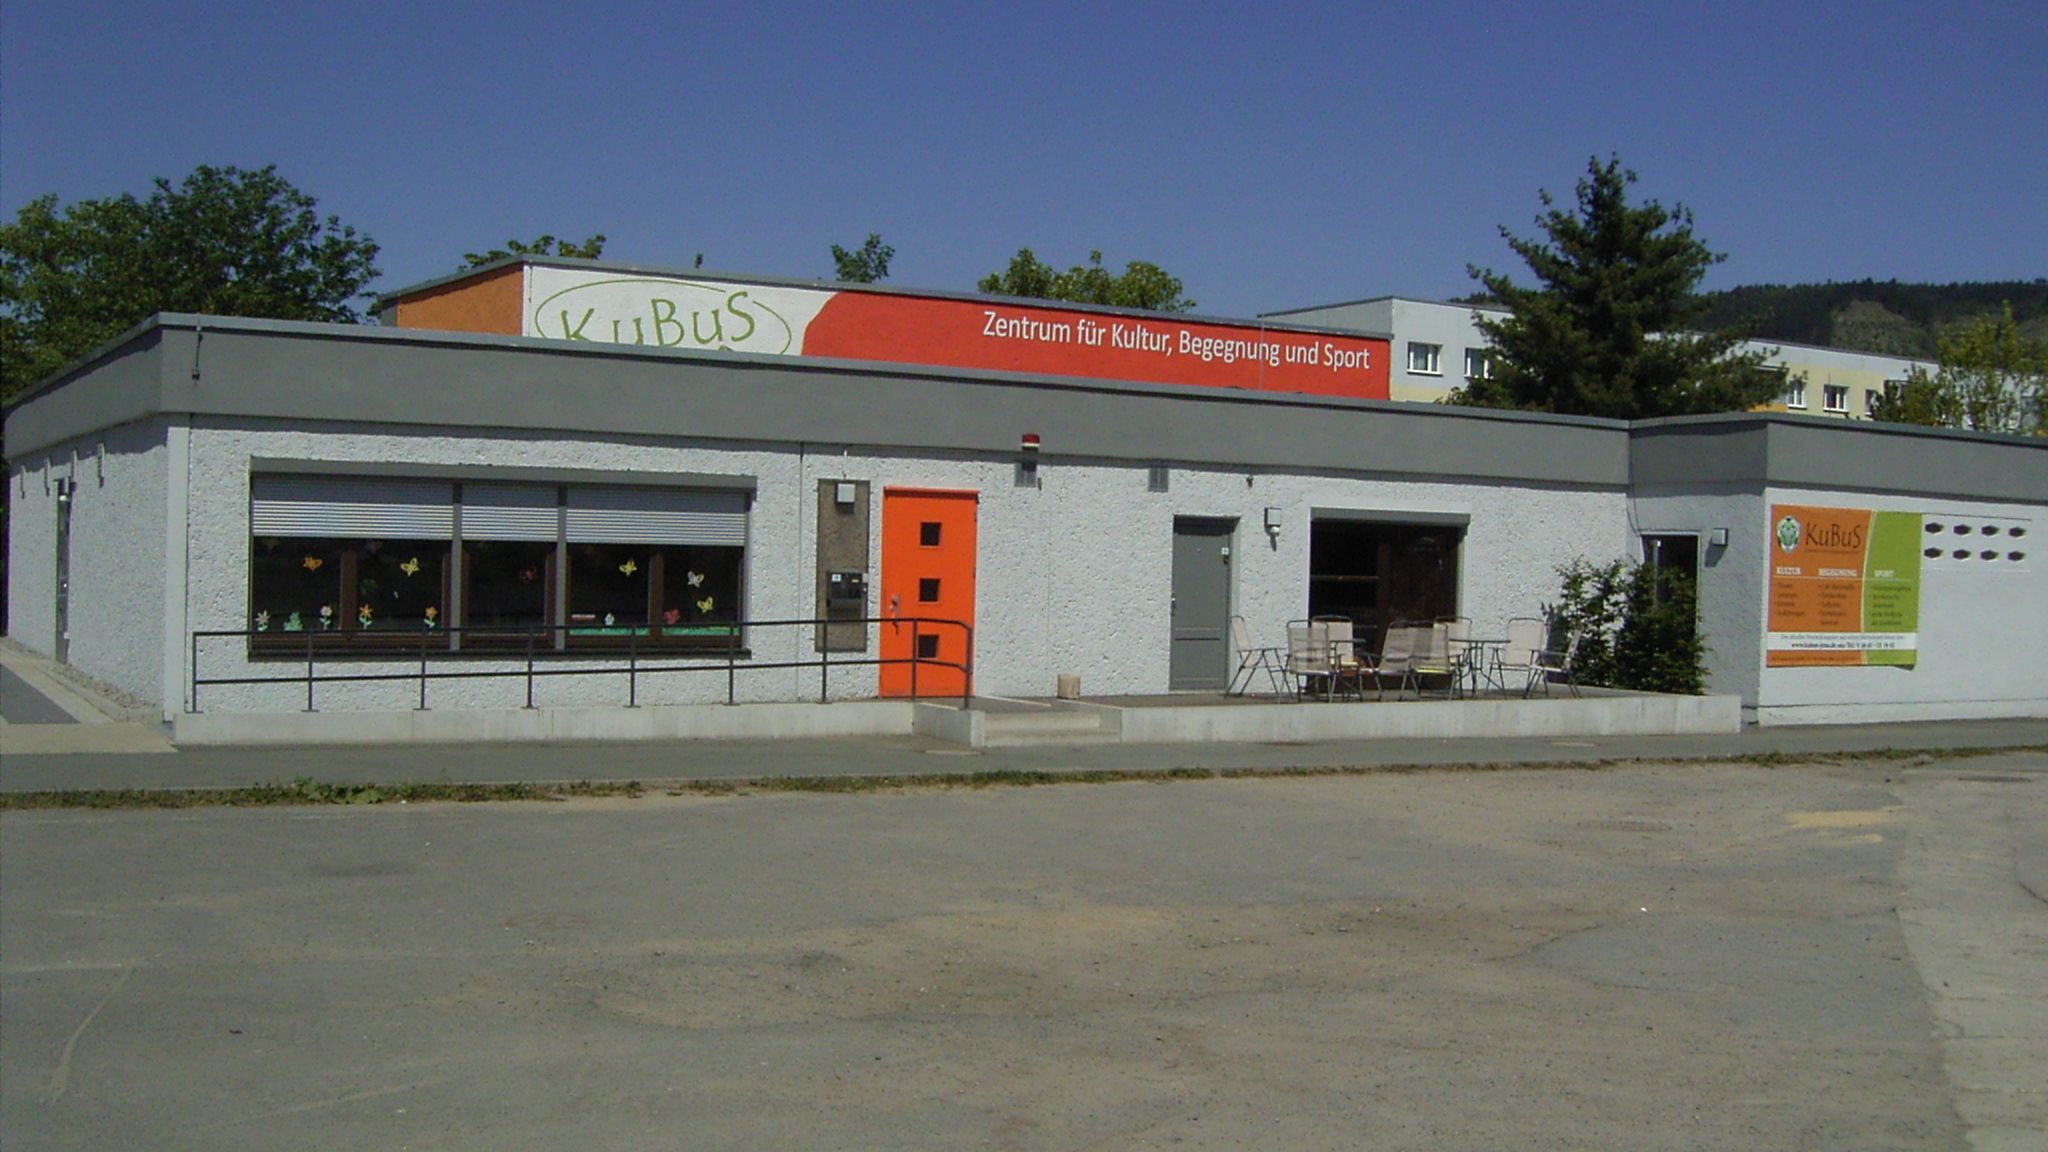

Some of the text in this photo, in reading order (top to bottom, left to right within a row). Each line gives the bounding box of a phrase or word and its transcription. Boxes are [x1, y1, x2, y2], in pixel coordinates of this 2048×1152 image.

[560, 290, 756, 347] KuBuS
[982, 311, 1371, 372] Zentrum für Kultur, Begegnung und Sport
[1805, 522, 1861, 549] KuBuS
